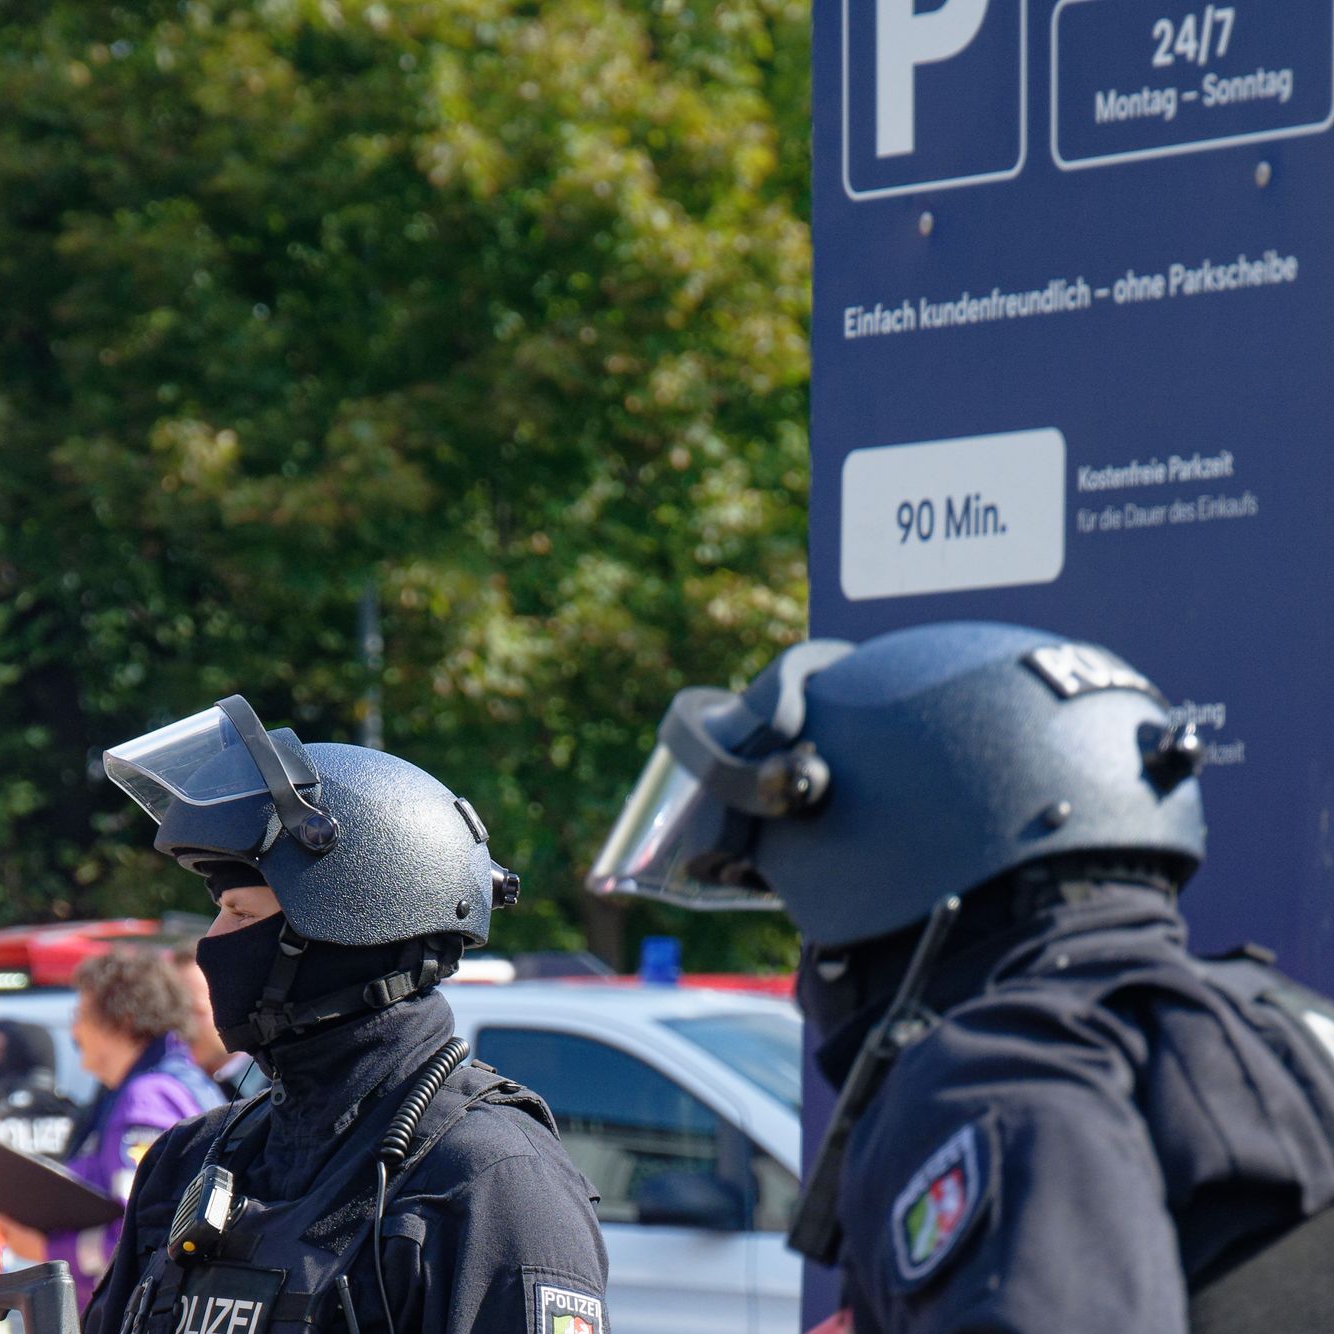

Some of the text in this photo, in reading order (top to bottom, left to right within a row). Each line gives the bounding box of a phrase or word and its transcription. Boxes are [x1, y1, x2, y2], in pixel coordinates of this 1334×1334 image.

[1152, 4, 1235, 67] 24/7
[876, 0, 989, 159] P
[1095, 86, 1178, 124] Montag
[1202, 68, 1293, 107] Sonntag
[844, 300, 916, 339] Einfach
[920, 276, 1091, 329] kundenfreundlich
[1113, 269, 1165, 304] ohne
[1169, 250, 1298, 297] Parkscheibe
[1077, 450, 1234, 492] Kostenfreie Parkzeit
[896, 493, 1007, 544] 90 Min.
[1124, 503, 1166, 528] Dauer
[544, 1290, 599, 1318] POLIZEI
